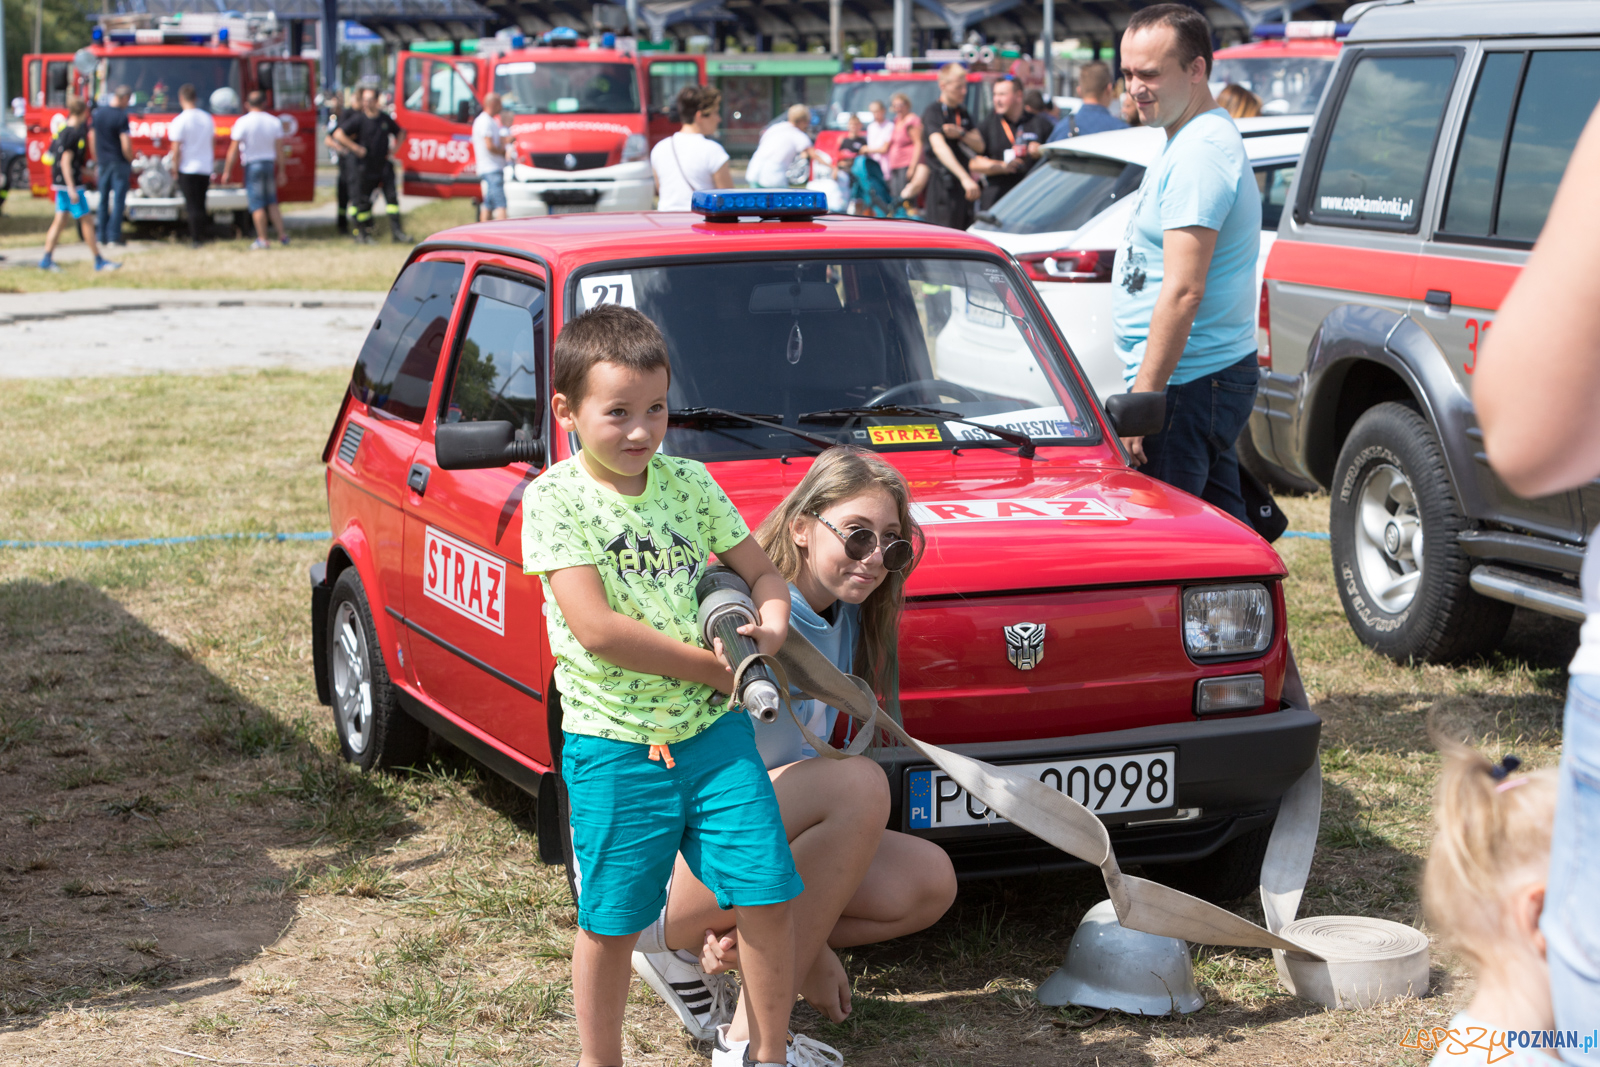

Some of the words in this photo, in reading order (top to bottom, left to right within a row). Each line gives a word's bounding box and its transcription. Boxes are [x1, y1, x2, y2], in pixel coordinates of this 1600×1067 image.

[1321, 194, 1413, 221] www.ospkamionki.pl
[592, 283, 623, 307] 27
[1463, 318, 1493, 375] 3
[604, 540, 703, 572] BAMAN
[911, 807, 928, 820] PL
